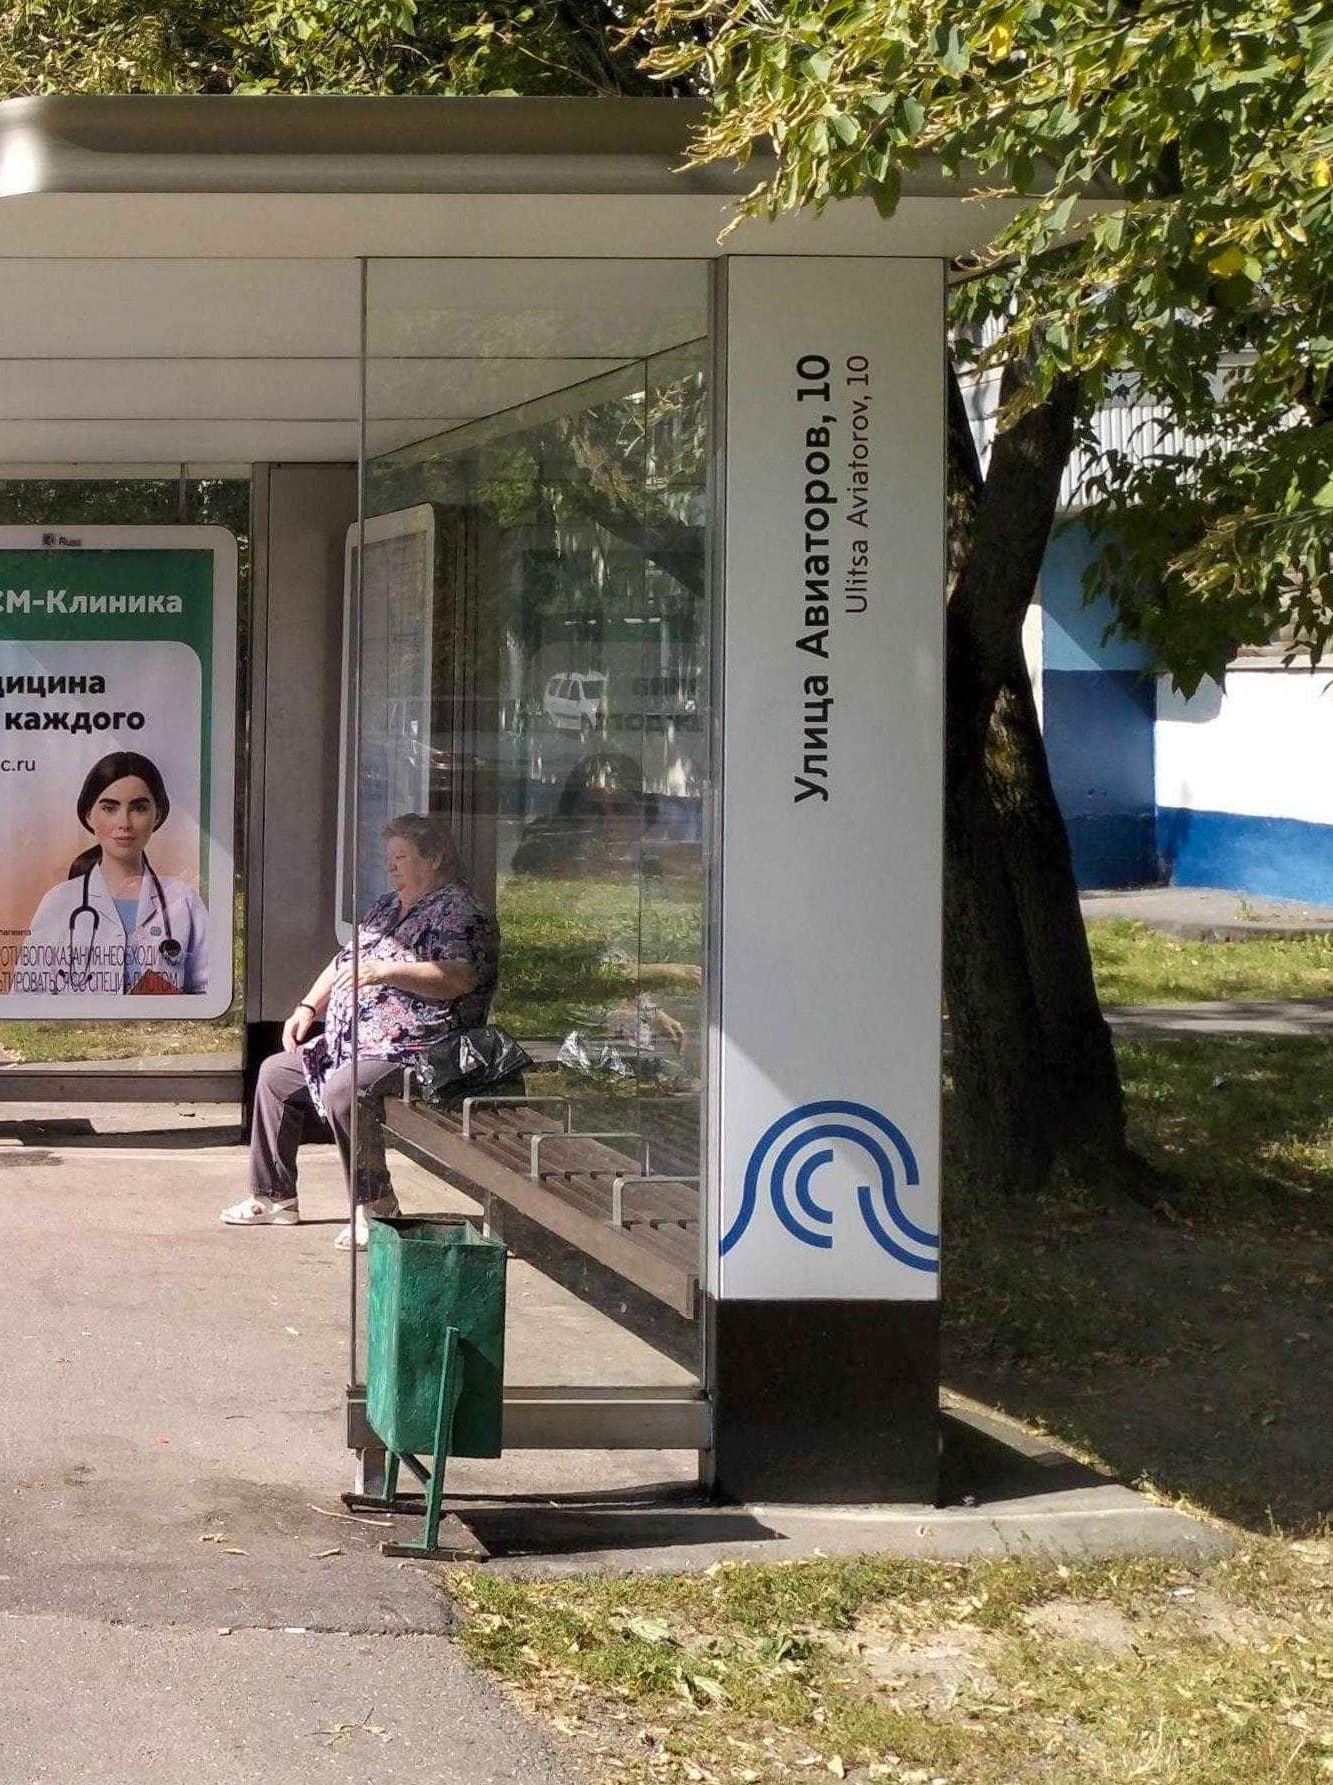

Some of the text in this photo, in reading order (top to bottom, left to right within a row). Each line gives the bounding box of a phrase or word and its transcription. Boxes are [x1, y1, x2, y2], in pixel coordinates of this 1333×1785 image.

[794, 354, 837, 803] Улица Авиаторов, 10
[844, 355, 873, 613] Ulitsa Aviatorov, 10
[4, 711, 146, 734] каждого
